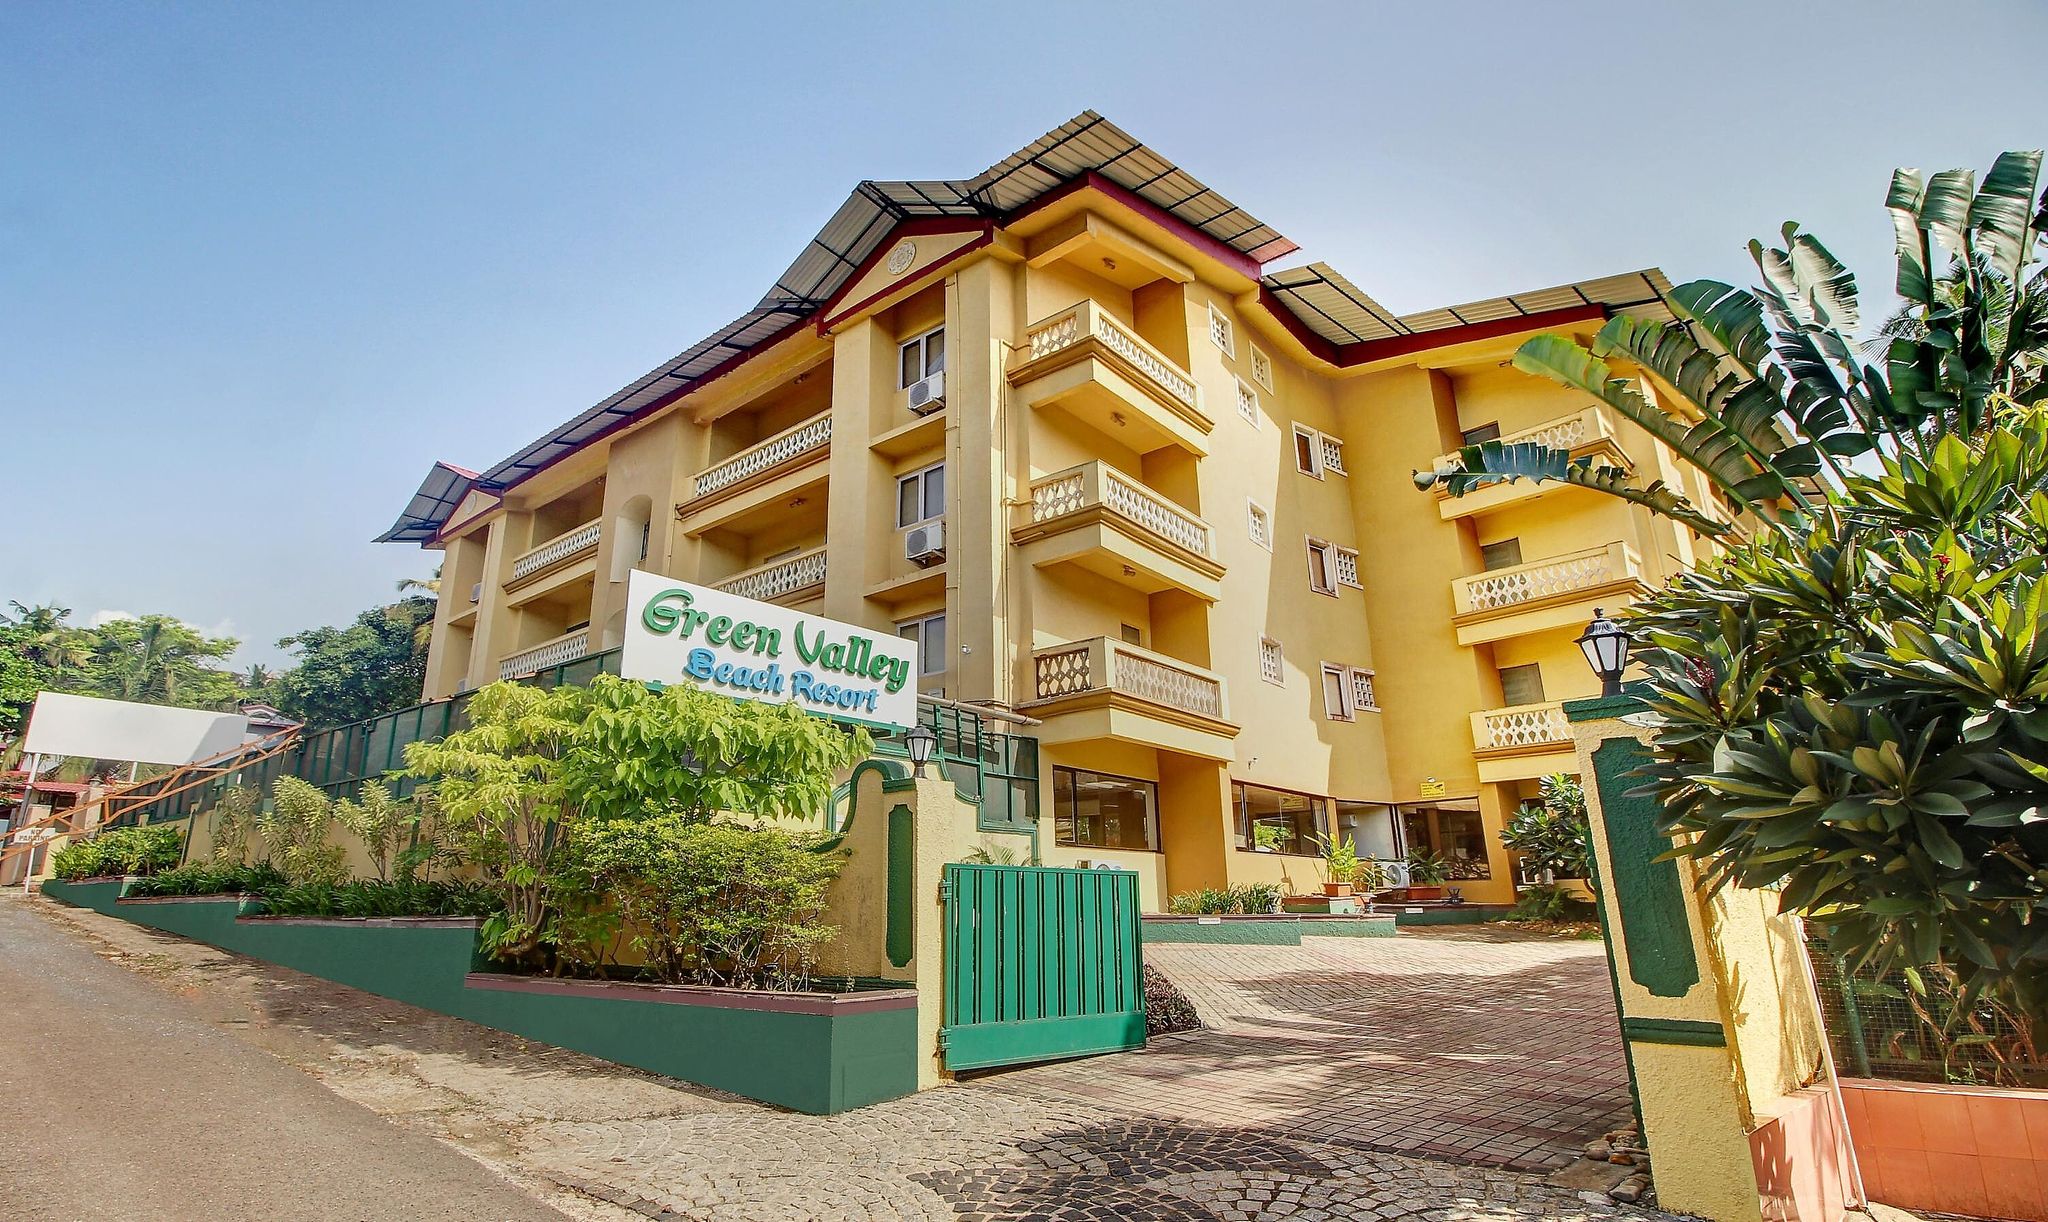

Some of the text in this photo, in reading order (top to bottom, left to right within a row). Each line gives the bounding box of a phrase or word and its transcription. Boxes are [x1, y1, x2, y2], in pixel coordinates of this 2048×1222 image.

[643, 588, 910, 693] Green Valley
[685, 647, 879, 712] Beach Resort
